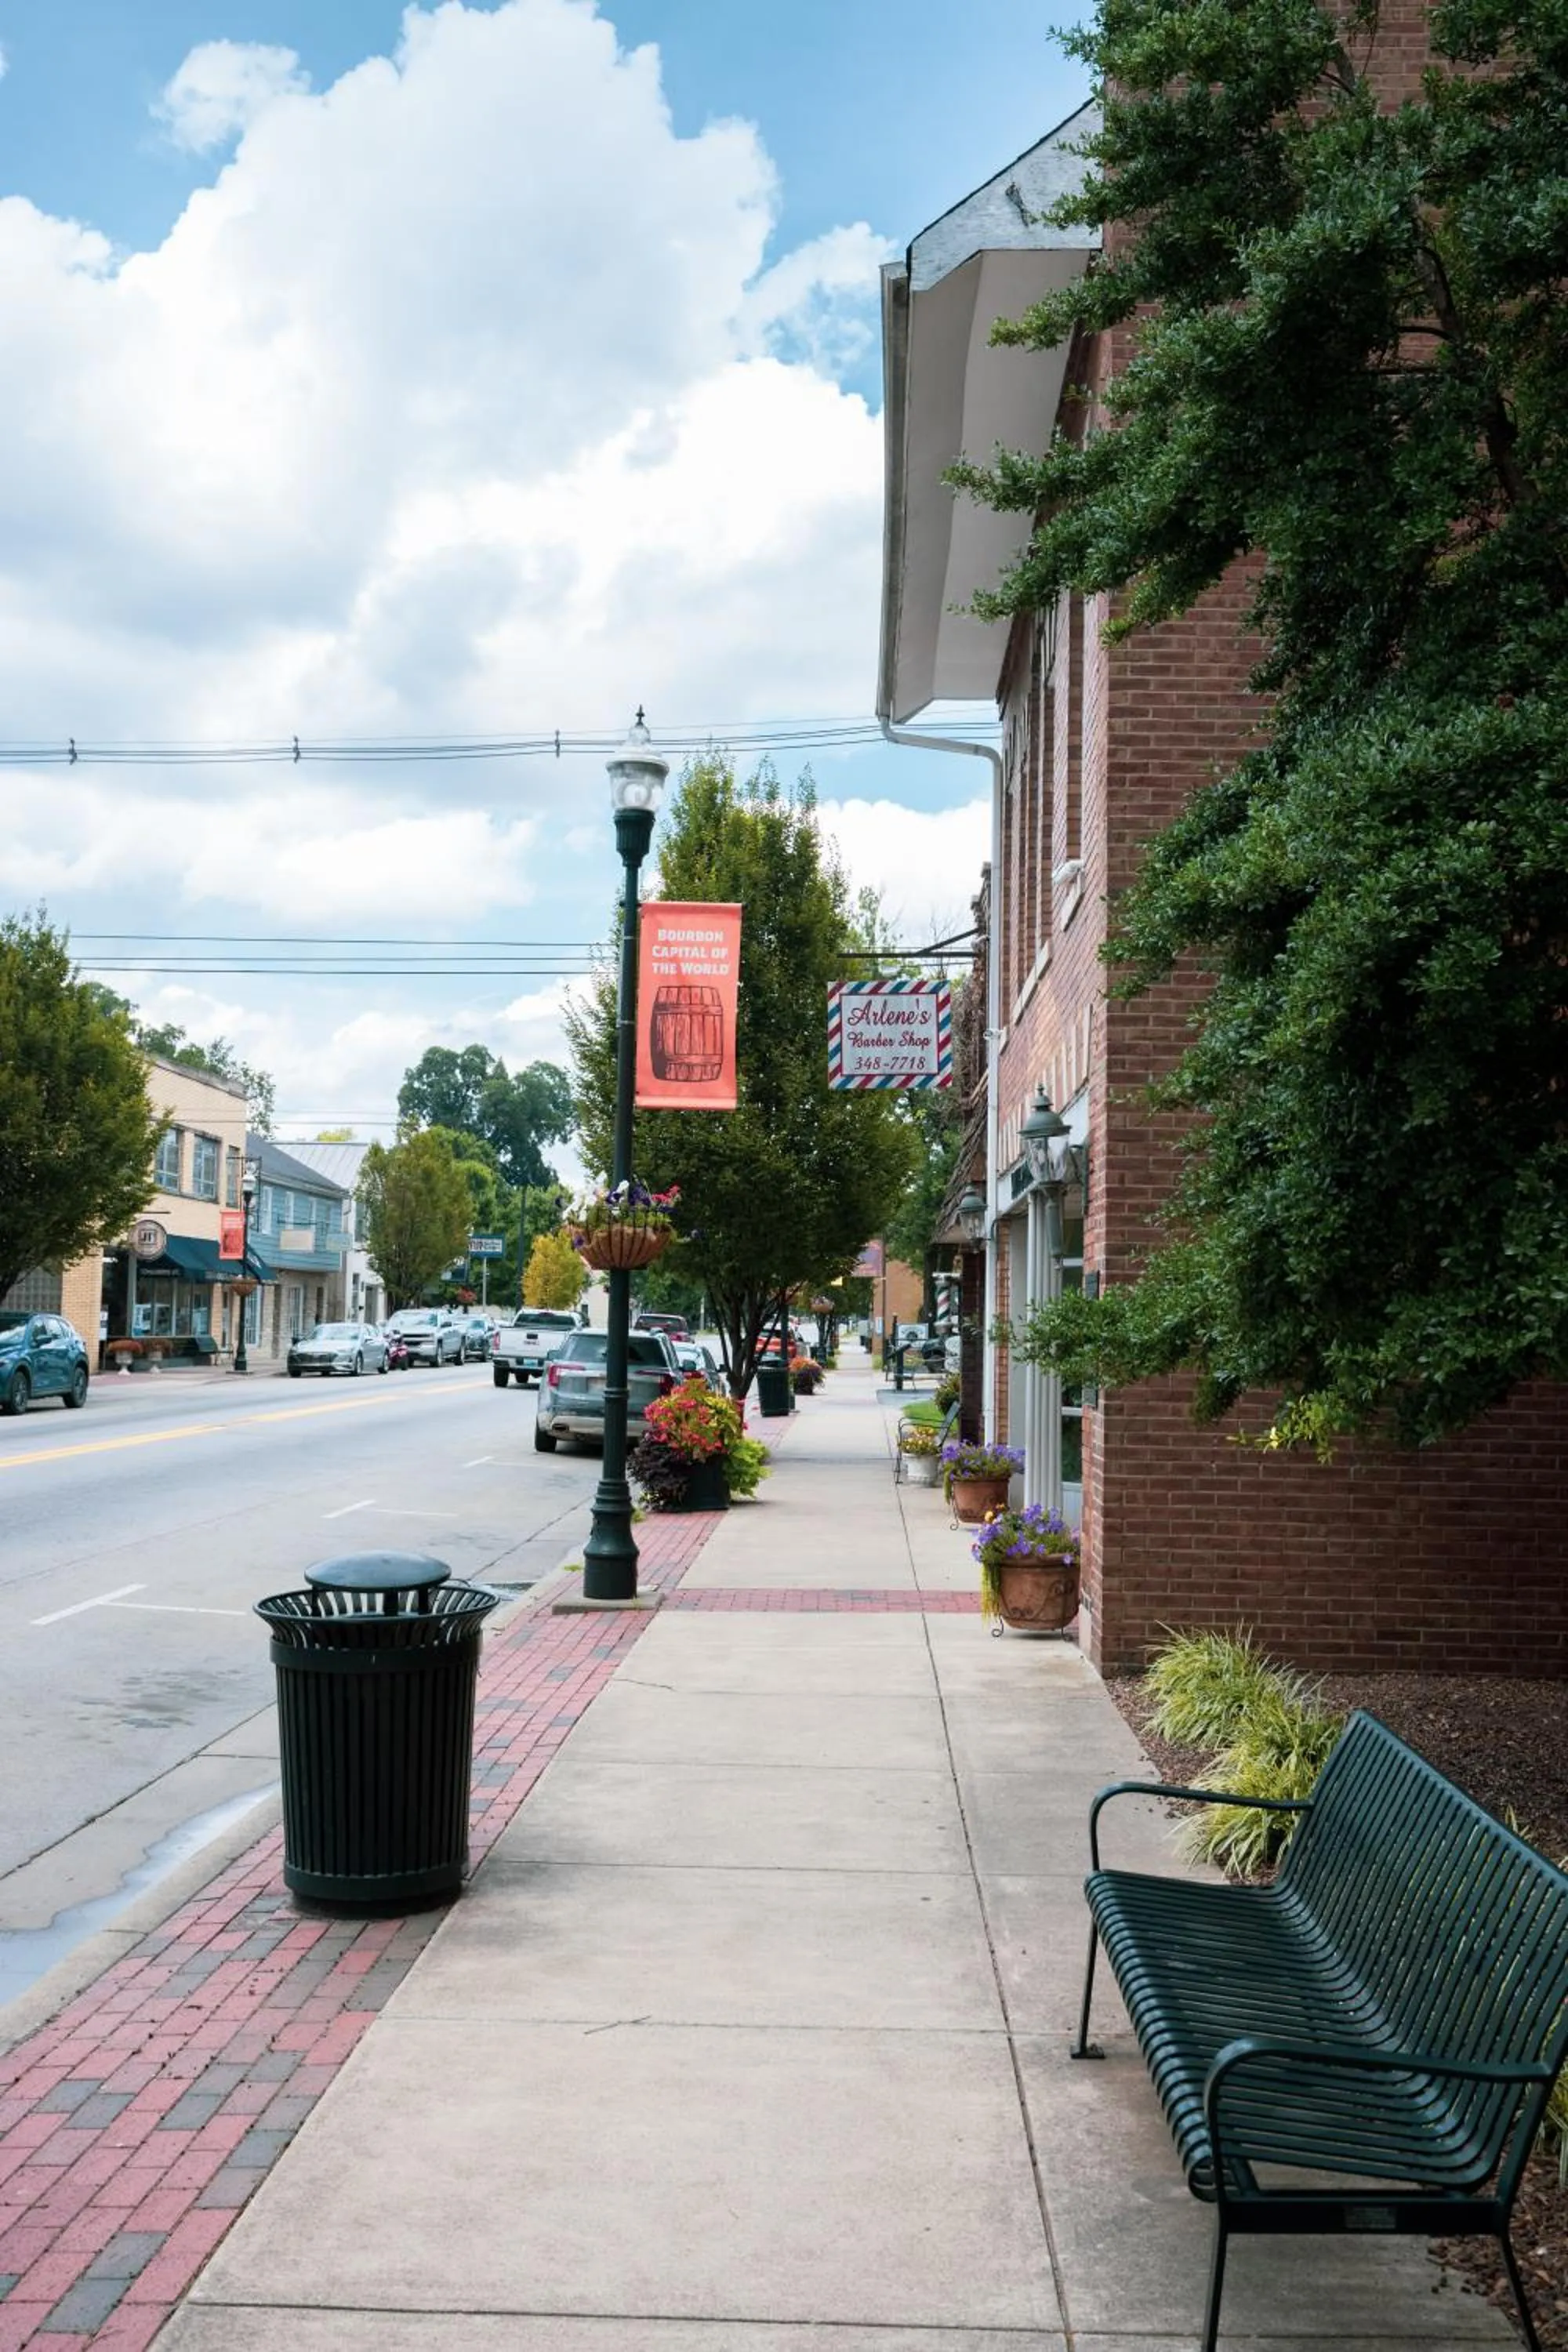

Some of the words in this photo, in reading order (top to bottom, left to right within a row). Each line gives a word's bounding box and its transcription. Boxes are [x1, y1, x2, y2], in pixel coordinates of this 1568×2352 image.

[658, 928, 724, 942] BOURBON
[652, 946, 709, 958] CAPITAL
[711, 947, 728, 959] OF
[652, 962, 677, 975] THE
[680, 962, 730, 975] WORLD
[848, 998, 931, 1026] Arlene's
[847, 1031, 895, 1048] Barber
[898, 1030, 931, 1051] Shop
[854, 1056, 926, 1071] 348-7718
